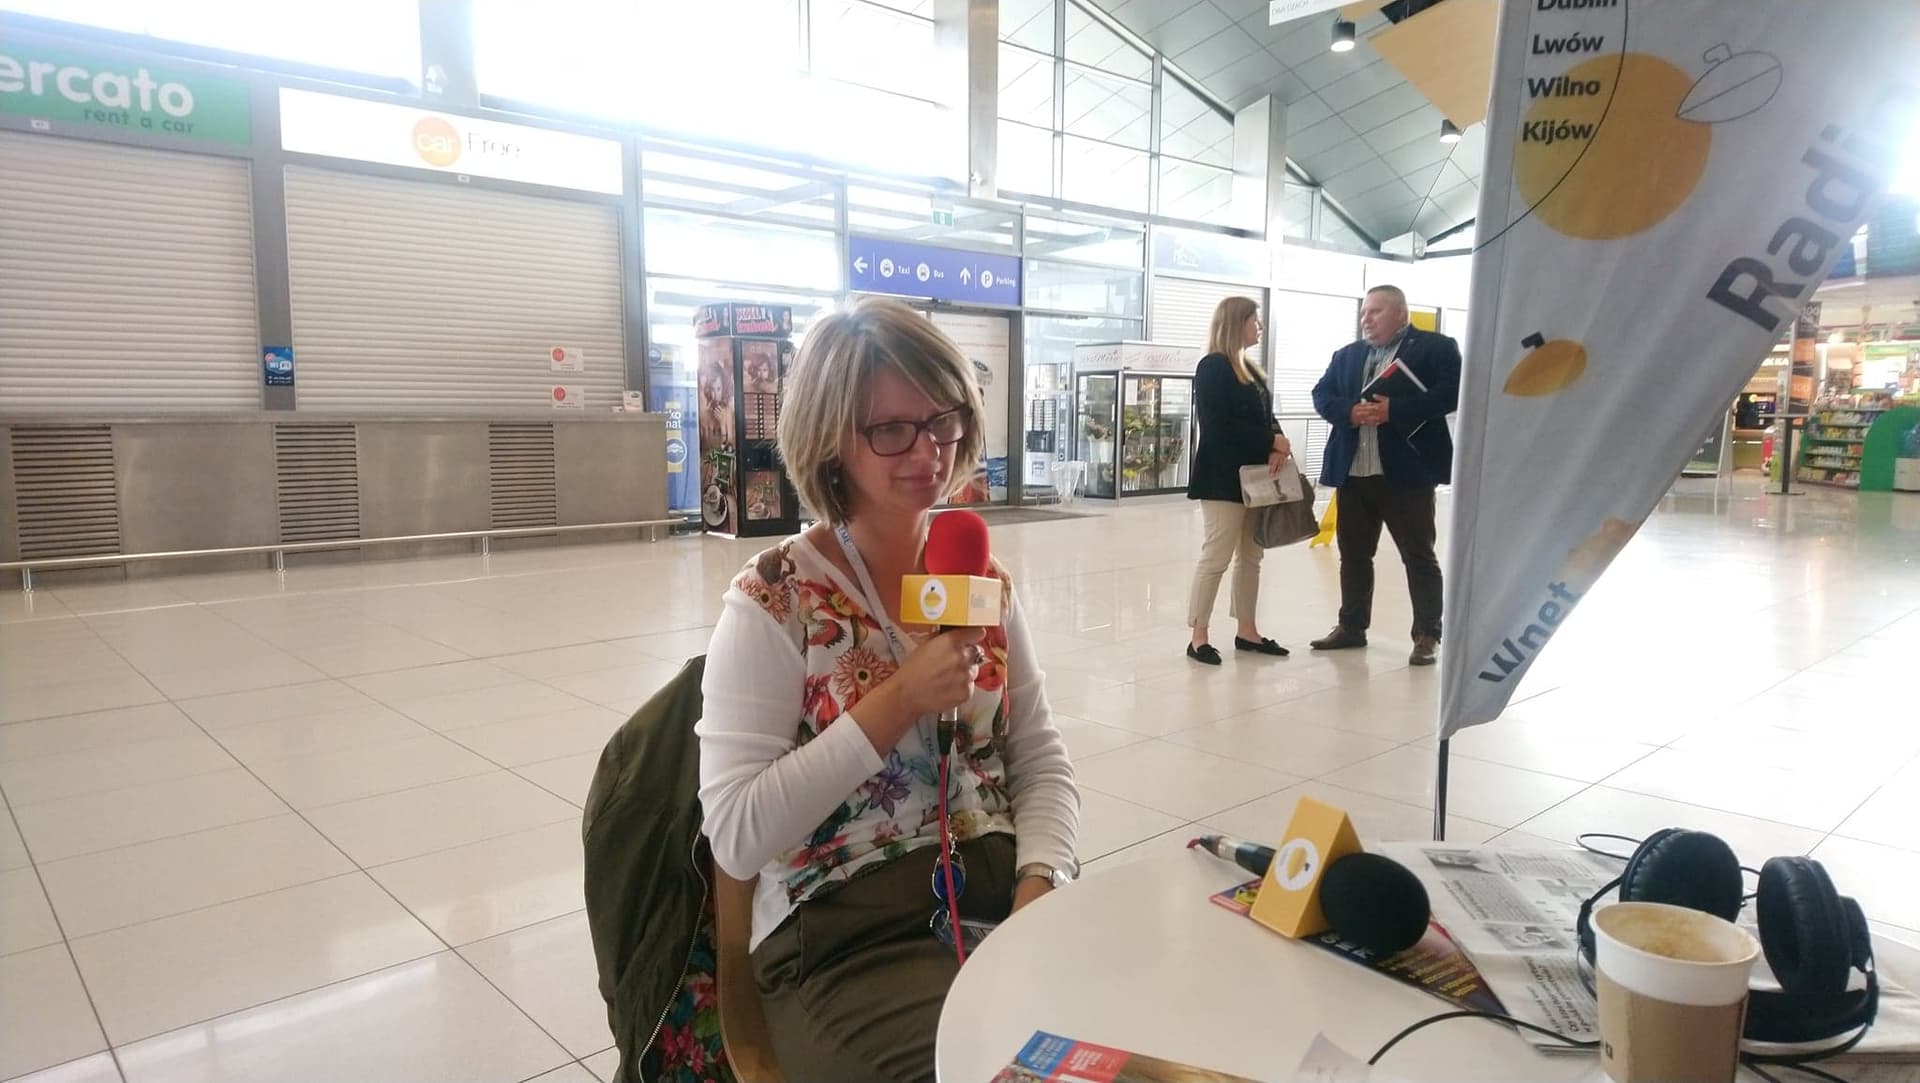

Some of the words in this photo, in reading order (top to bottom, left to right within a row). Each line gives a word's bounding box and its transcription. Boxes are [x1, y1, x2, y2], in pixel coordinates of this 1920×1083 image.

[1532, 31, 1604, 55] Lwów
[1527, 75, 1601, 98] Wilno
[83, 108, 129, 126] rent
[140, 116, 153, 129] a
[162, 119, 194, 134] car
[1522, 119, 1594, 146] Kijów
[897, 264, 911, 275] Taxi
[933, 269, 945, 279] Bus
[995, 276, 1016, 287] Parking
[1478, 581, 1581, 683] Wnet
